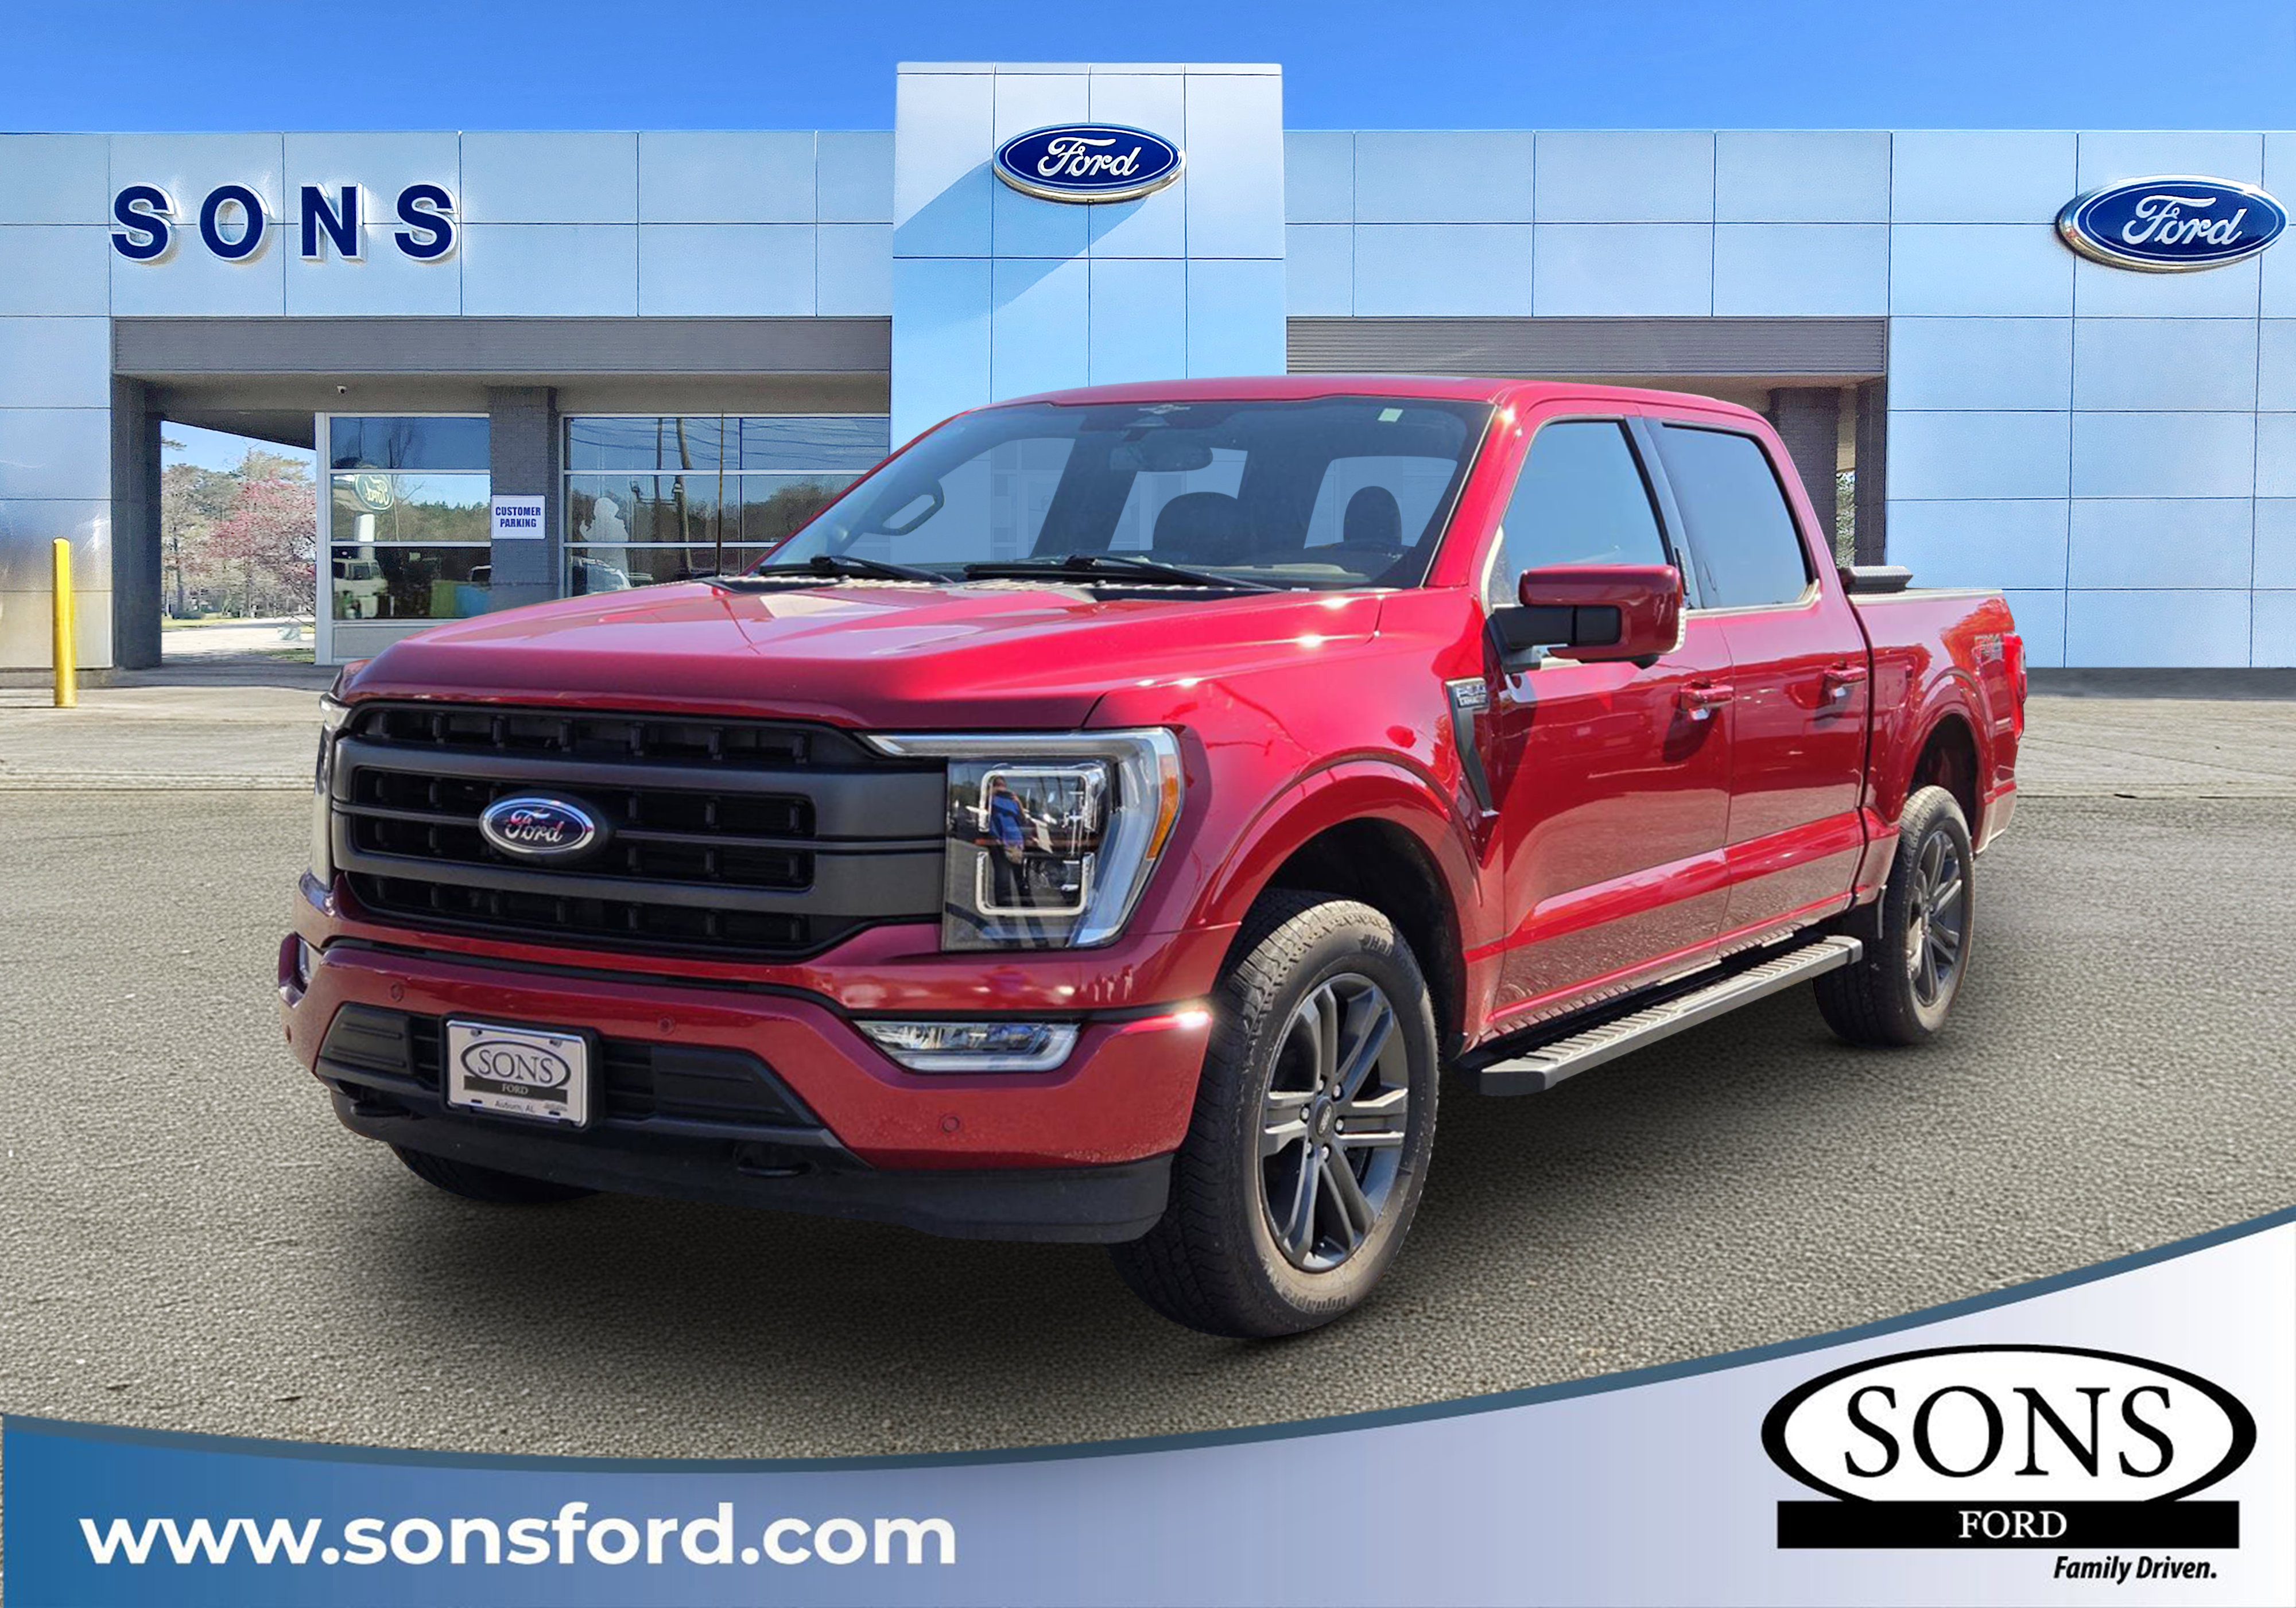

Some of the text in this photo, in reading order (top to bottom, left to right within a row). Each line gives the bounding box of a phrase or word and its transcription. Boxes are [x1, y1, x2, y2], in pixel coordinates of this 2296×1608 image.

[1037, 136, 1142, 177] Ford
[111, 183, 459, 261] SONS
[2121, 195, 2248, 246] Ford
[495, 506, 541, 516] CUSTOMER
[500, 518, 537, 527] PARKING
[505, 809, 565, 842] Ford
[478, 1048, 554, 1085] SONS
[501, 1082, 529, 1096] FORD
[494, 1100, 523, 1112] Auburn,
